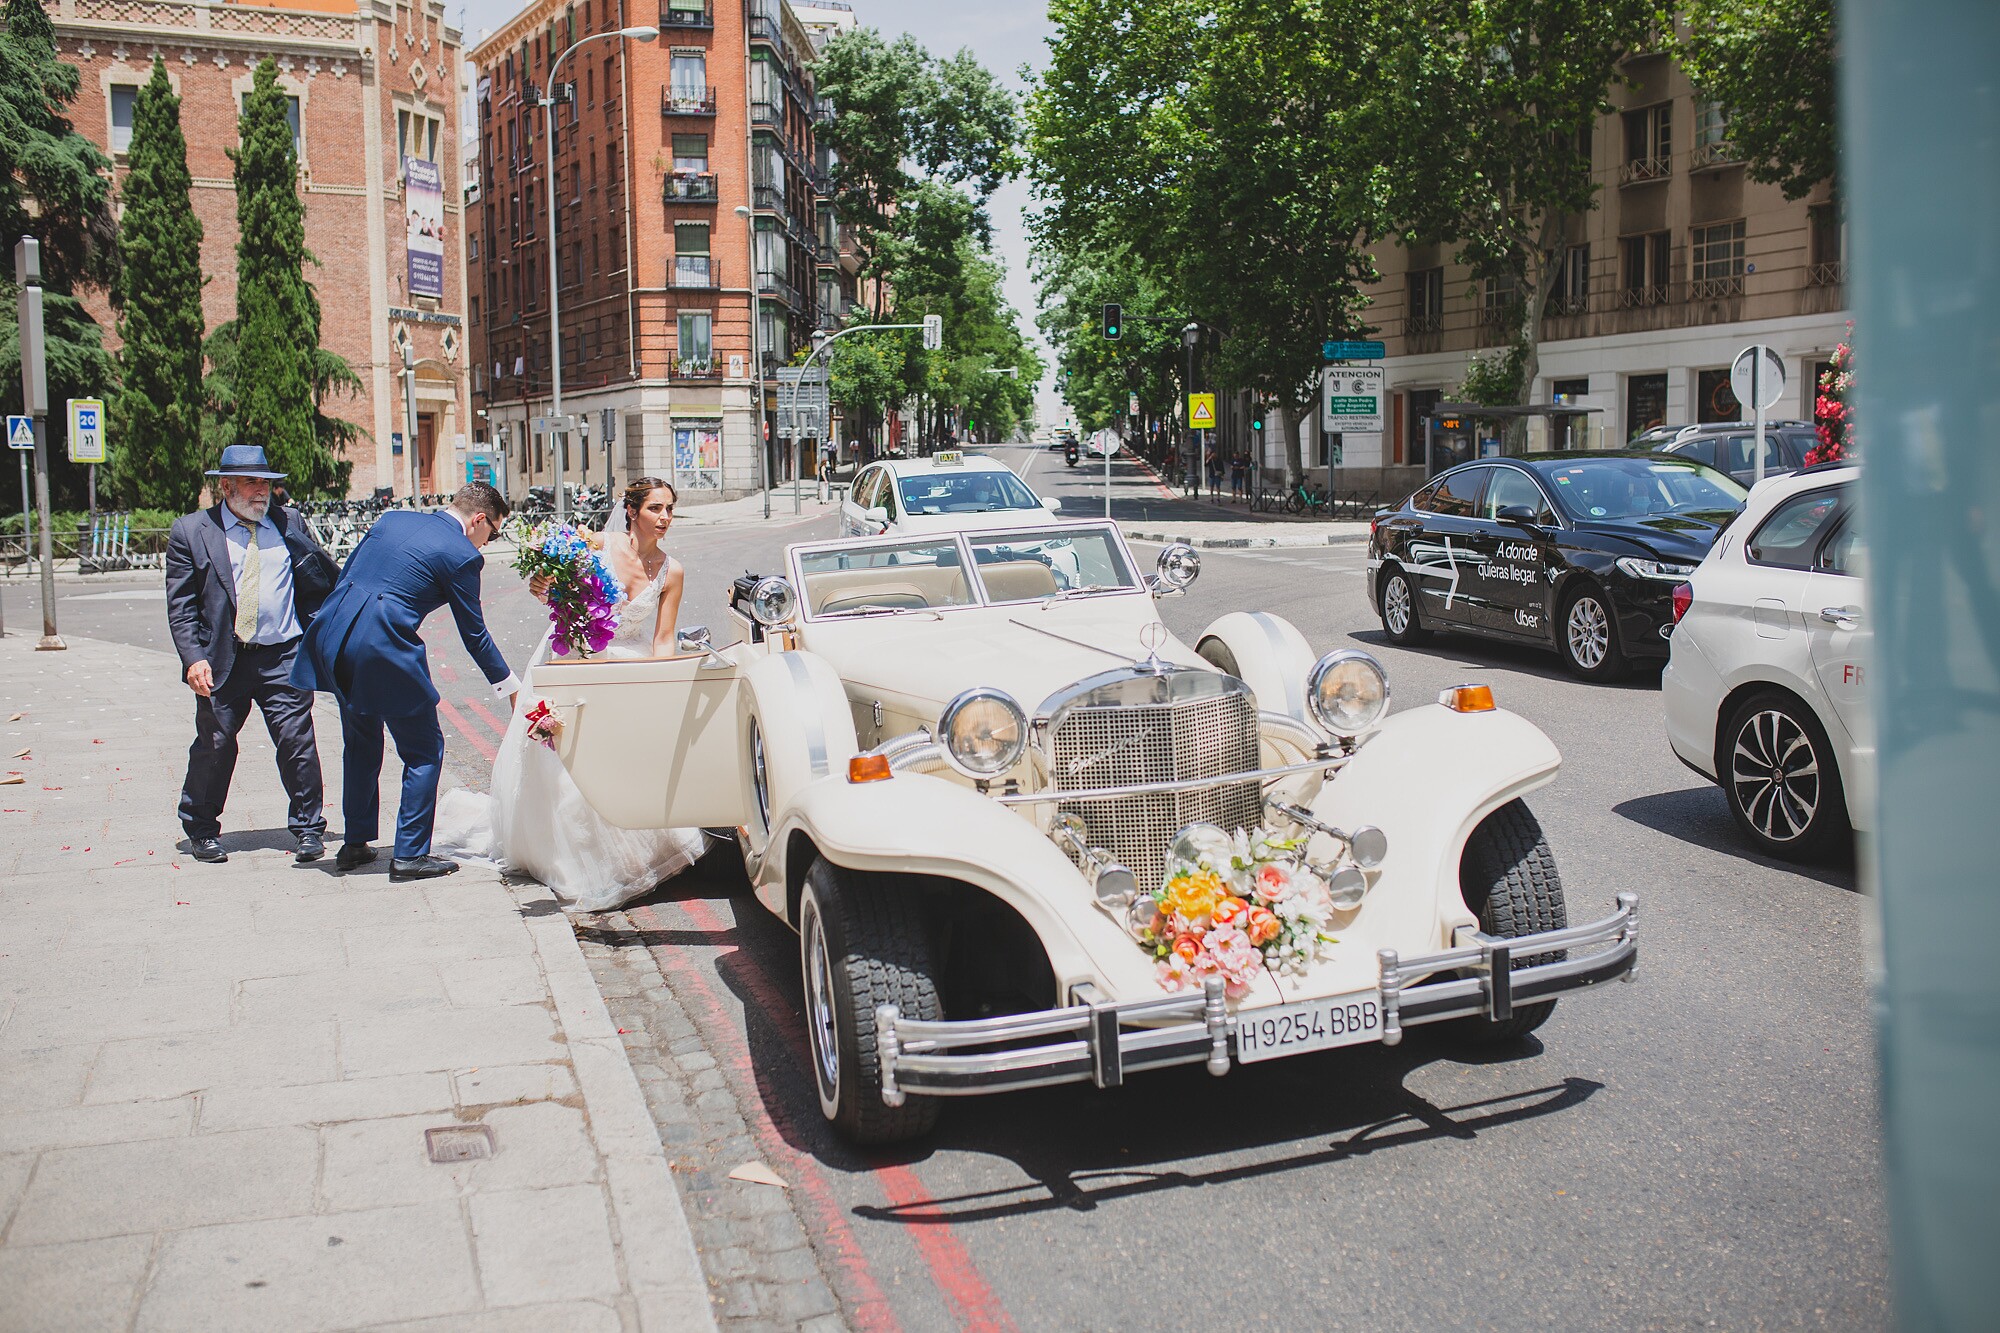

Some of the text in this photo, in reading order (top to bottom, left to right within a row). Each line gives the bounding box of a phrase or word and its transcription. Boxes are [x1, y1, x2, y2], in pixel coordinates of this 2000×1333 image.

[1328, 370, 1381, 378] ATENCIÓN
[80, 415, 95, 426] 20
[940, 453, 955, 462] TAXI
[1496, 541, 1538, 561] A donde
[1477, 563, 1538, 587] quieras llegar.
[1514, 608, 1539, 628] Uber
